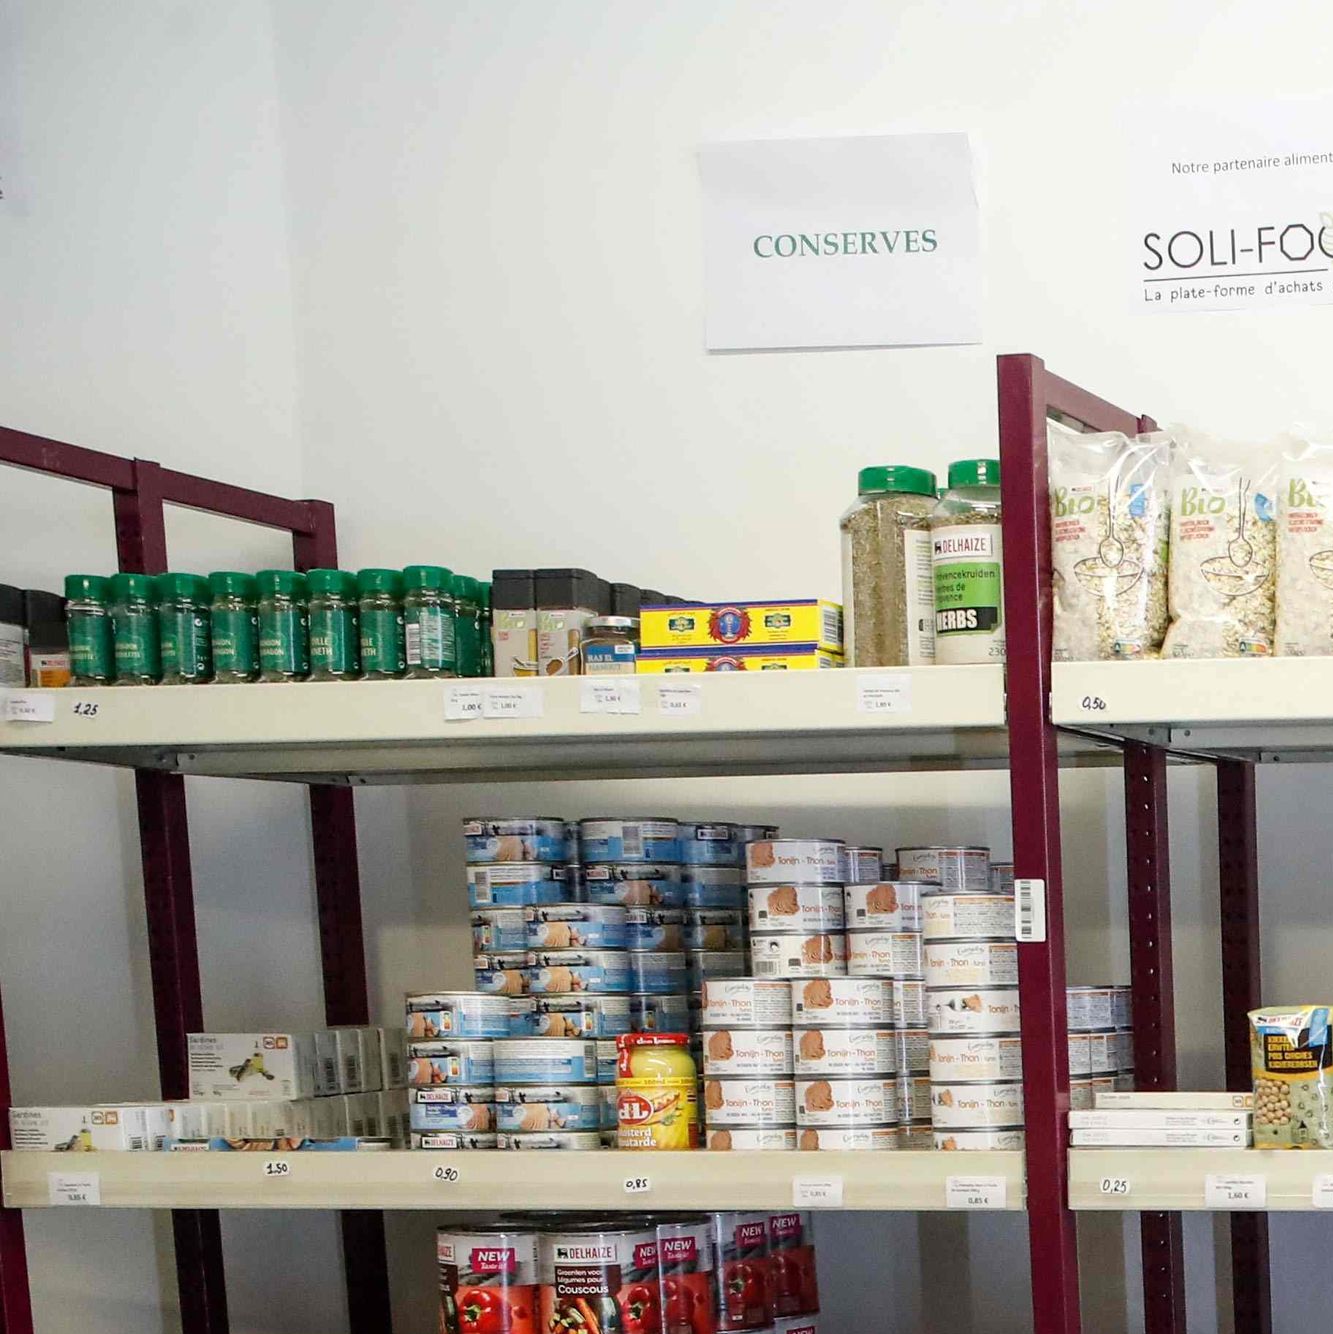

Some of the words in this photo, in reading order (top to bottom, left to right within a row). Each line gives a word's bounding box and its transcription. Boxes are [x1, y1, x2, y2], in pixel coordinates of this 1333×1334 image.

[1171, 160, 1209, 174] Notre
[1213, 153, 1280, 172] partenaire
[753, 229, 938, 259] CONSERVES
[1144, 288, 1162, 302] La
[1170, 283, 1255, 303] plate-forme
[1265, 279, 1324, 294] d'achats
[943, 538, 986, 553] DELHAIZE
[73, 703, 97, 716] 1,25
[1082, 697, 1106, 710] 0,50
[435, 1167, 457, 1180] 0,90
[626, 1179, 647, 1189] 0,85
[1102, 1180, 1127, 1194] 0,25
[665, 1241, 691, 1250] NEW
[478, 1251, 510, 1261] NEW
[570, 1248, 612, 1259] DELHAIZE
[559, 1285, 609, 1294] Couscous
